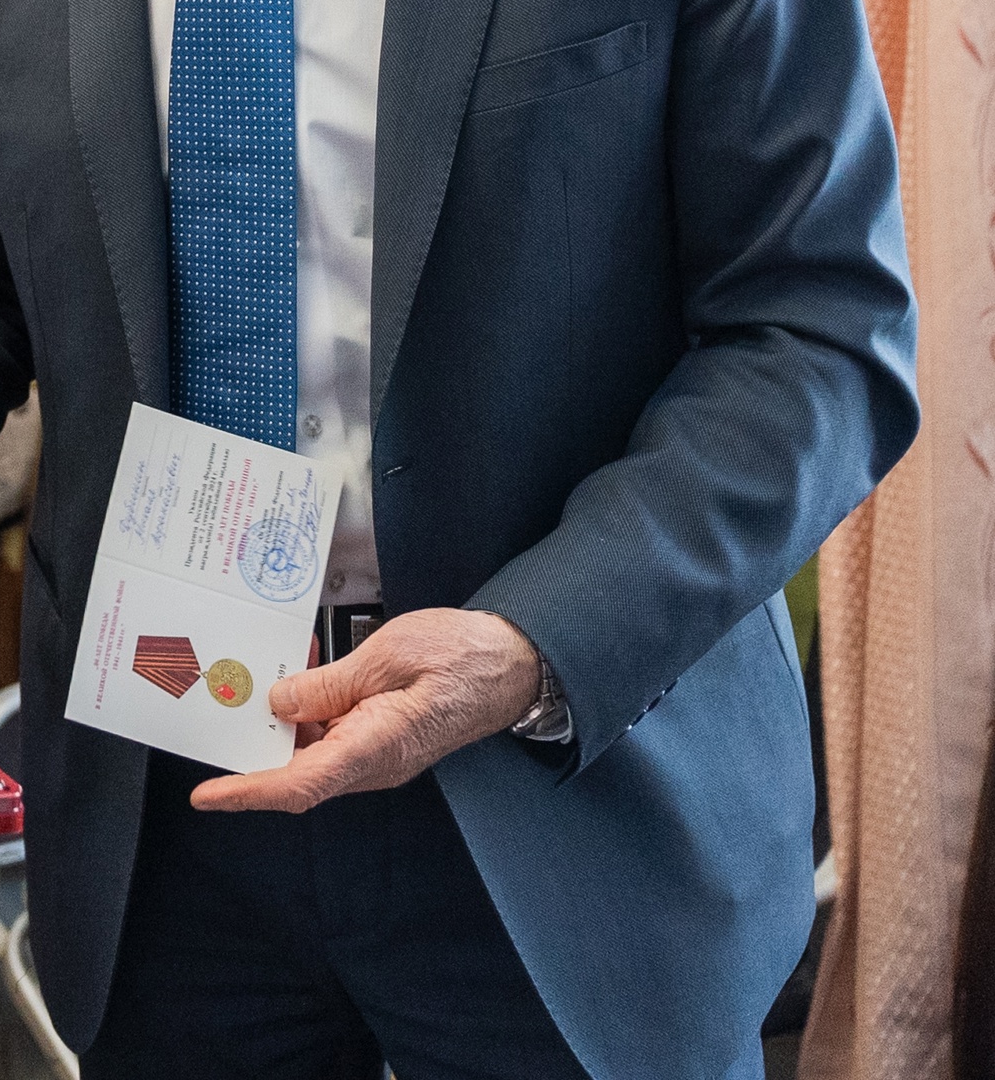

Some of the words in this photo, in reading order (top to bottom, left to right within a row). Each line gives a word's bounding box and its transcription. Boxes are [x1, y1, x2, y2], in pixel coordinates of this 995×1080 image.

[224, 479, 235, 513] ПОБЕДЫ
[224, 527, 236, 566] ВЕЛИКОЙ
[233, 458, 251, 525] ОТЕЧЕСТВЕННОЙ
